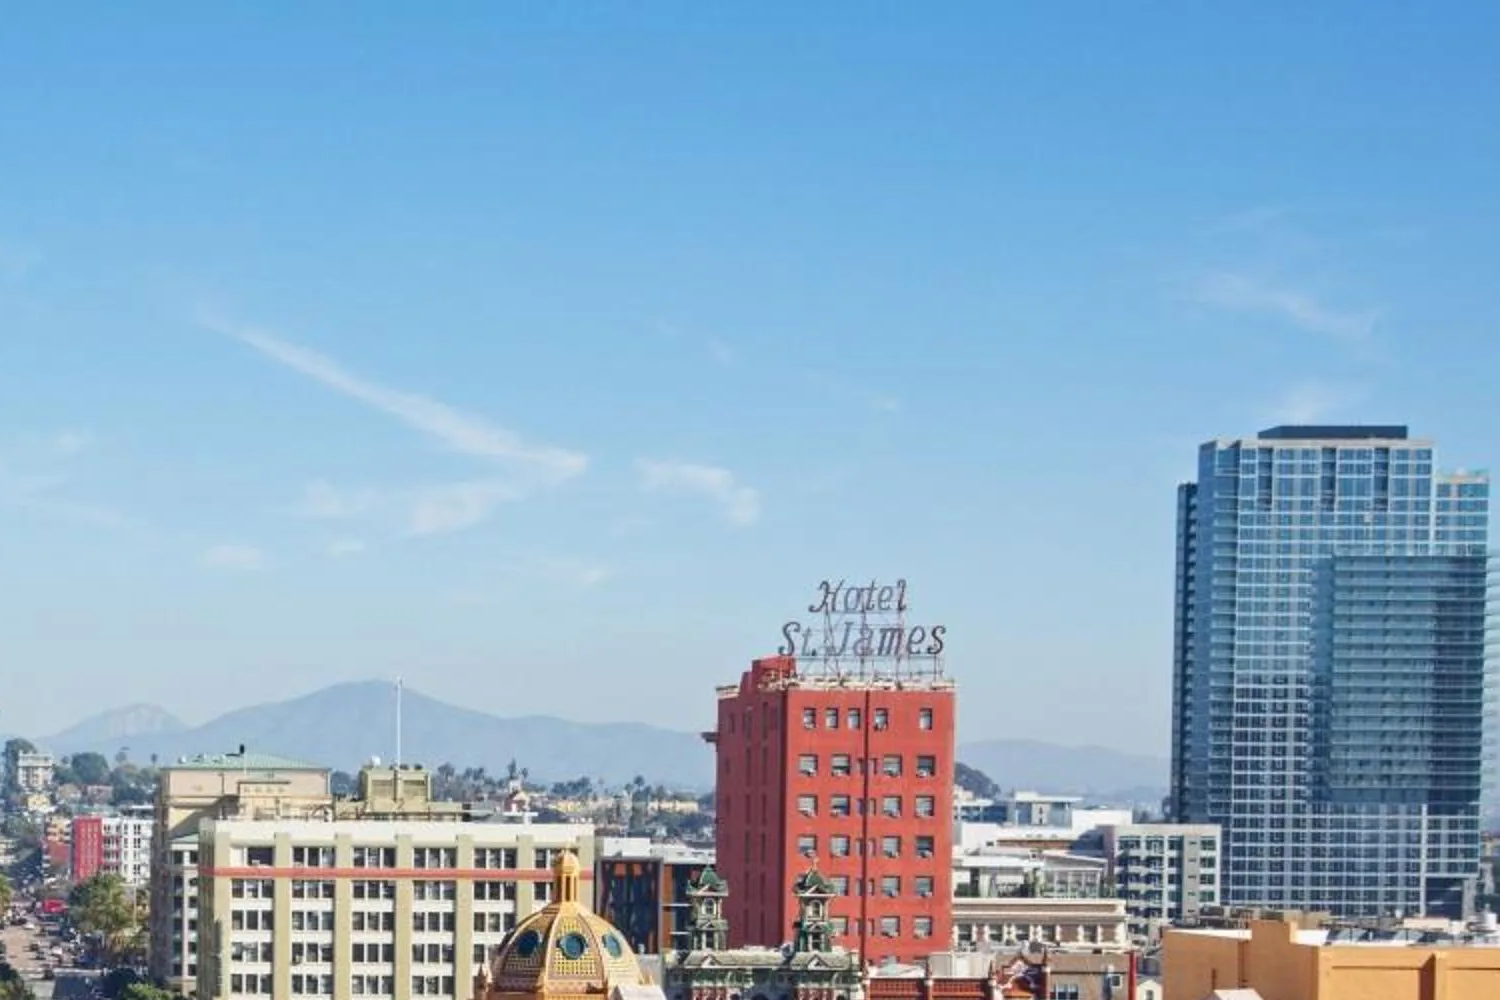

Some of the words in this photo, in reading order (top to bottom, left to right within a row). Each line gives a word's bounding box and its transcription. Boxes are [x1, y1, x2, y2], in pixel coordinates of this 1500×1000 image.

[808, 579, 907, 613] Hotel
[777, 621, 817, 657] St.
[826, 621, 947, 657] James
